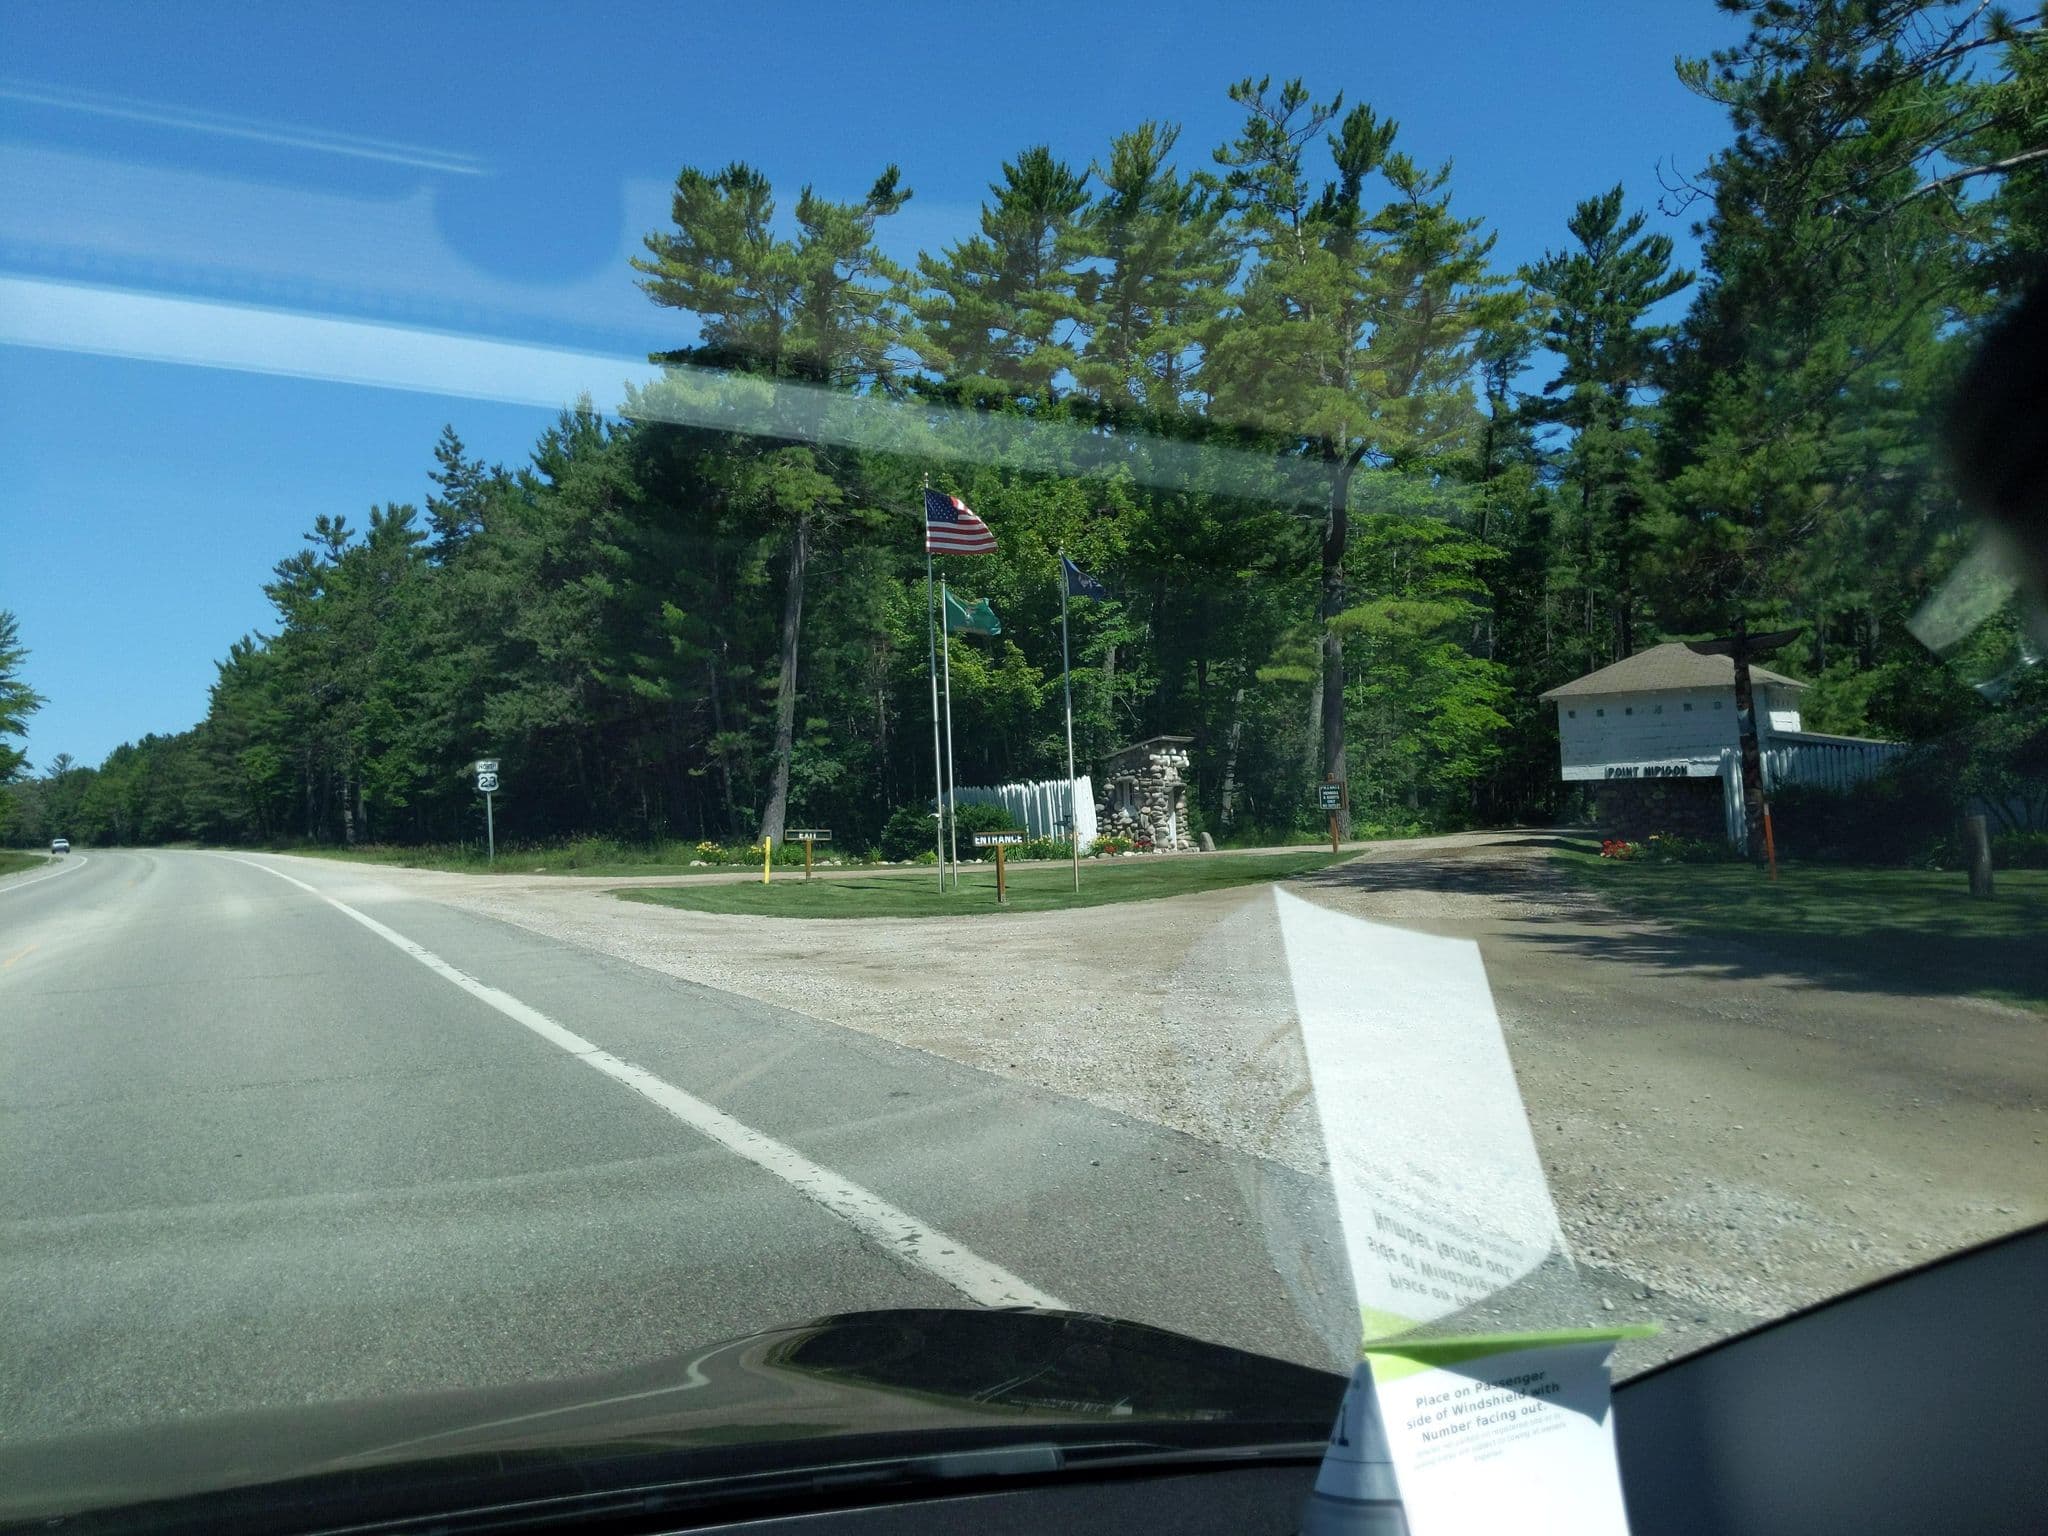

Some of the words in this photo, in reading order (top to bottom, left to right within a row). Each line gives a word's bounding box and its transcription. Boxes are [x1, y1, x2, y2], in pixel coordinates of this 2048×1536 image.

[480, 776, 497, 787] 23
[1607, 767, 1639, 777] POINT
[1643, 766, 1688, 776] NIPIGON
[975, 834, 1023, 845] ENTRANCE
[1415, 1391, 1451, 1409] Place
[1454, 1387, 1471, 1399] on
[1475, 1370, 1546, 1395] Passenger
[1406, 1413, 1432, 1431] side
[1436, 1408, 1450, 1422] of
[1452, 1389, 1526, 1417] Windshield
[1530, 1381, 1561, 1398] with
[1422, 1420, 1472, 1443] Number
[1476, 1407, 1517, 1428] facing
[1521, 1401, 1548, 1416] out.
